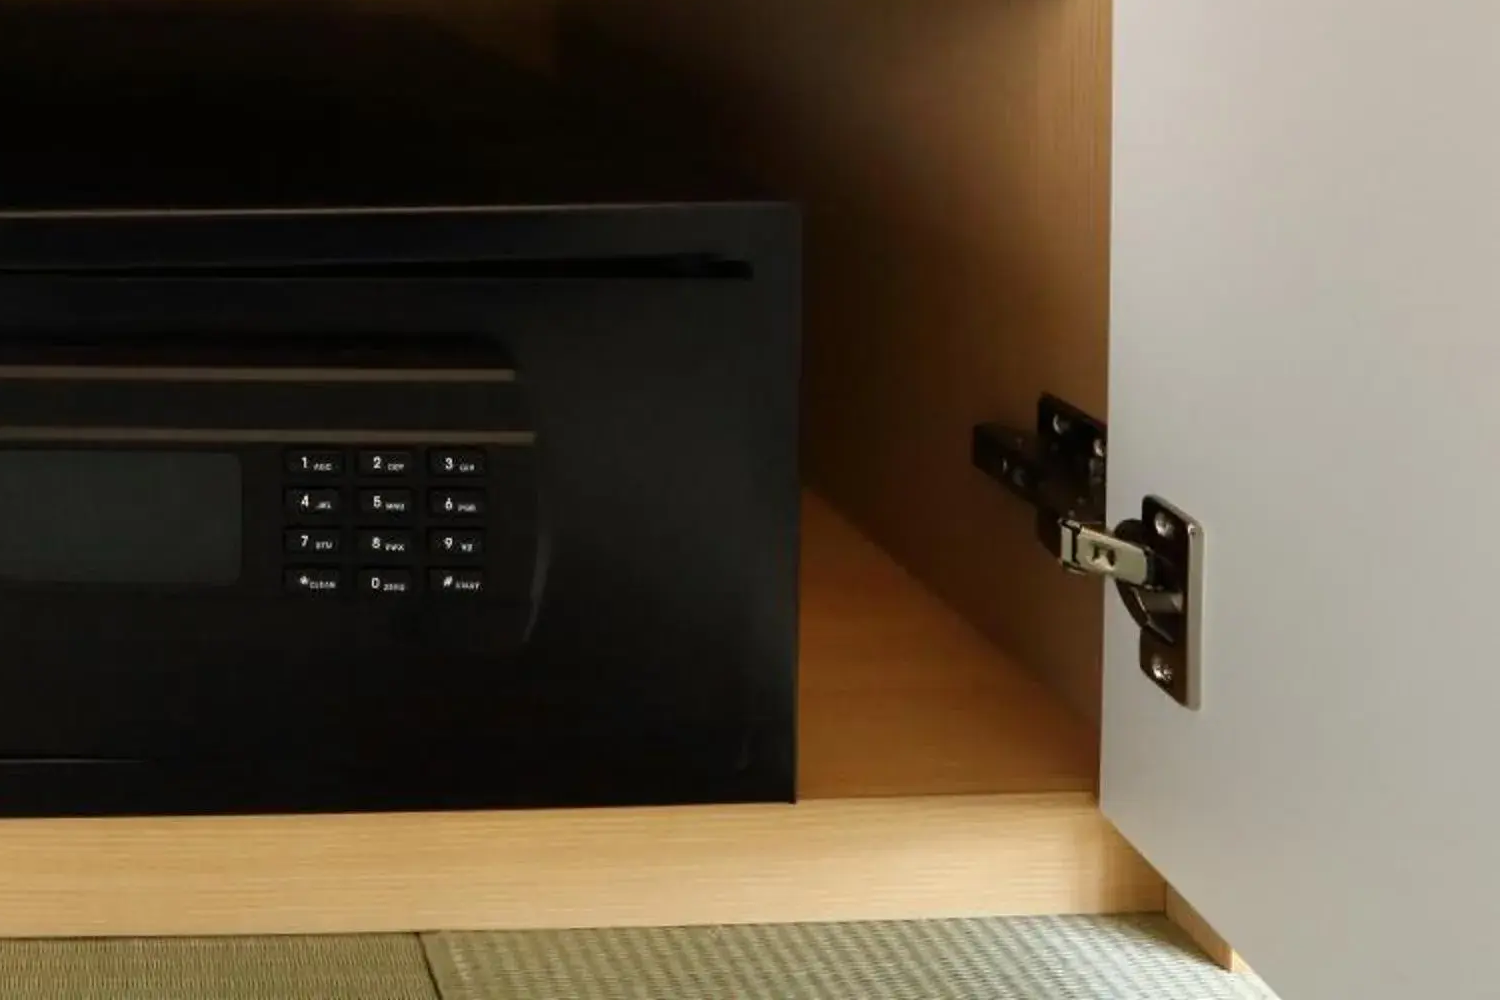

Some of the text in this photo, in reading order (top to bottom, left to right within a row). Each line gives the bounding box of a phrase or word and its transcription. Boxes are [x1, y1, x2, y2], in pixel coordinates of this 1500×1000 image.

[301, 457, 308, 469] 1
[373, 456, 381, 469] 2
[445, 457, 453, 470] 3
[301, 494, 309, 508] 4
[373, 495, 381, 508] 5
[445, 497, 453, 510] 6
[301, 535, 309, 547] 7
[372, 536, 381, 548] 8
[444, 537, 453, 549] 9
[371, 577, 380, 589] 0
